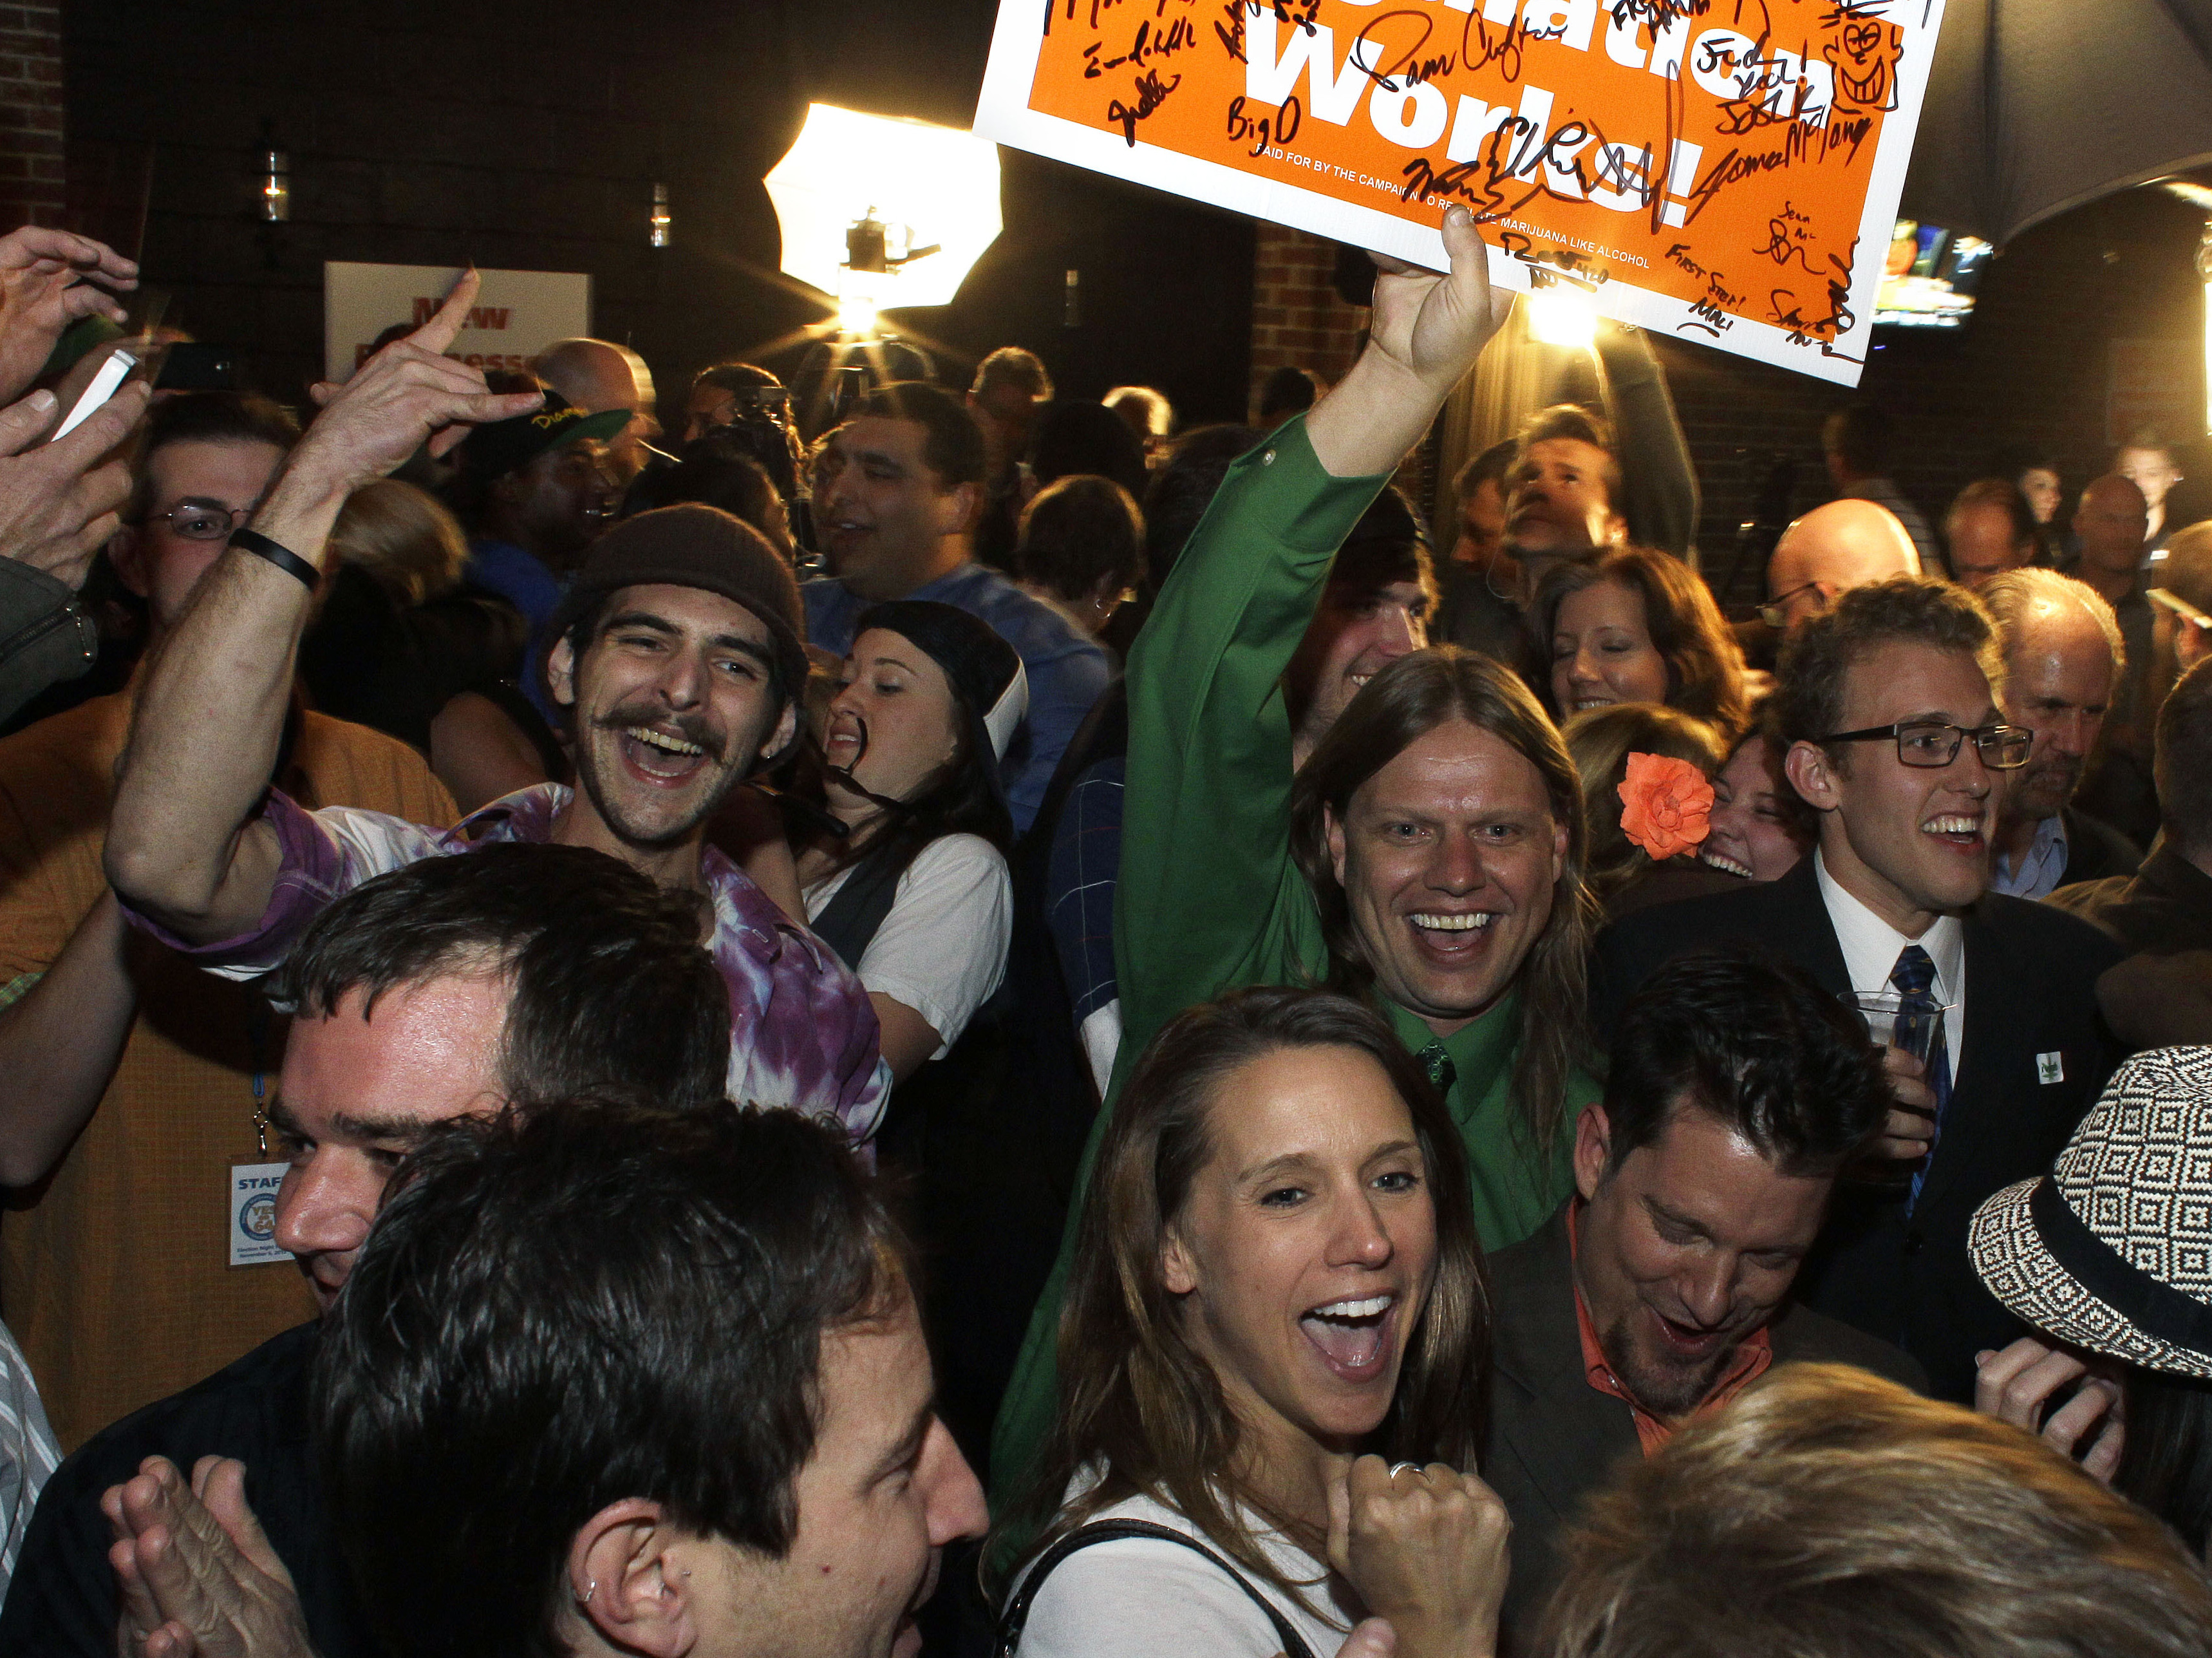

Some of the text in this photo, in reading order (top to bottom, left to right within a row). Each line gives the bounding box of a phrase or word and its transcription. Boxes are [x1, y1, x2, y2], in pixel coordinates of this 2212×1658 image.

[1227, 95, 1270, 157] Big
[1245, 0, 1704, 229] Works!
[1286, 151, 1311, 169] FOR
[1313, 160, 1331, 174] BY
[1333, 165, 1356, 182] THE
[1501, 218, 1567, 243] MARIJUANA
[1570, 236, 1596, 252] LIKE
[1597, 245, 1651, 269] ALCOHOL
[238, 1176, 281, 1190] STAF
